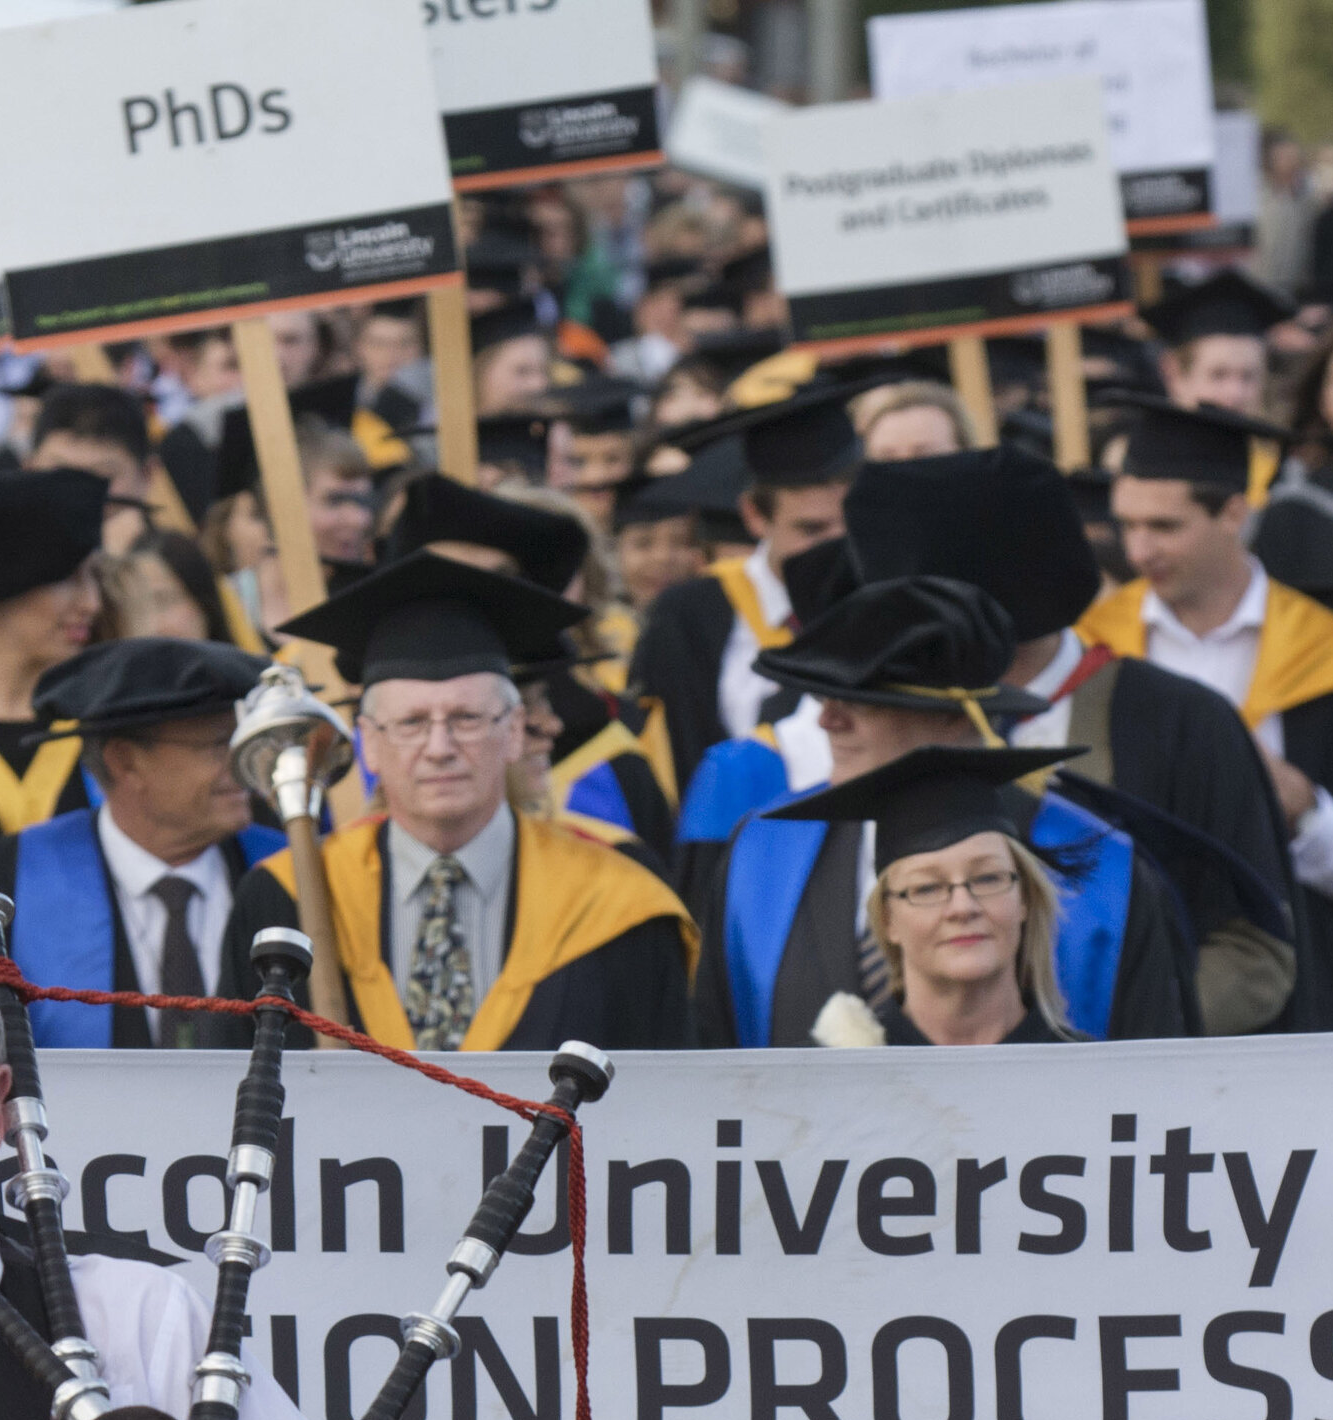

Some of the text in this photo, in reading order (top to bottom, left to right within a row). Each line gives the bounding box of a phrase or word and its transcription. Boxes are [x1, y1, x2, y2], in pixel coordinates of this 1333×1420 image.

[123, 82, 292, 154] PhDs
[781, 143, 1093, 197] Postgraduate Diplomas
[839, 187, 1051, 233] and Certificates
[335, 222, 410, 249] Lincoln
[339, 236, 436, 267] University
[480, 1112, 1318, 1289] University
